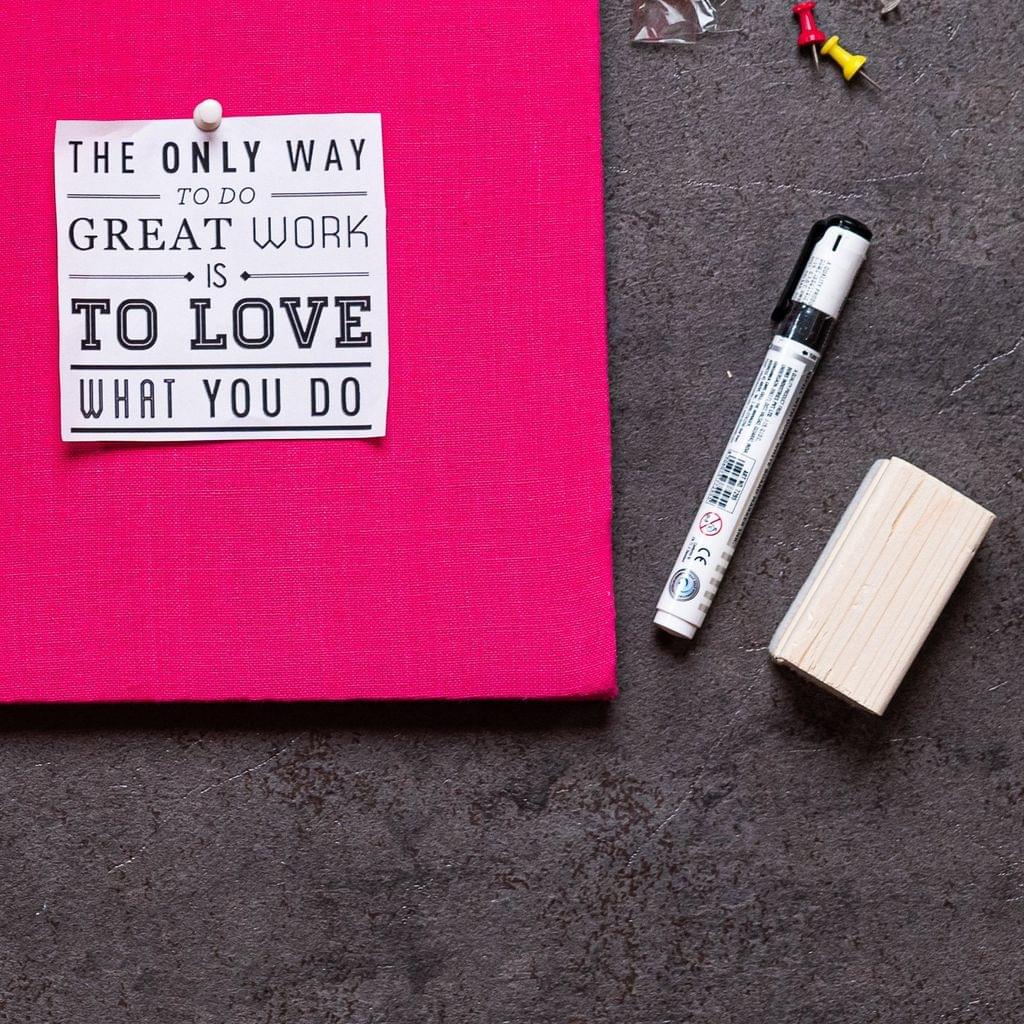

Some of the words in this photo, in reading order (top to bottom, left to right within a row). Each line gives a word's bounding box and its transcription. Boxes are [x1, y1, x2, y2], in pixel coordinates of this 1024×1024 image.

[69, 141, 134, 173] THE
[163, 141, 260, 173] ONLY
[287, 139, 365, 171] WAY
[177, 187, 210, 205] TO
[219, 187, 255, 204] DO
[69, 218, 232, 251] GREAT
[253, 215, 368, 249] WORK
[207, 263, 226, 288] IS
[71, 298, 157, 350] TO
[190, 296, 371, 350] LOVE
[80, 379, 175, 418] WHAT
[203, 379, 280, 417] YOU
[311, 377, 360, 416] DO
